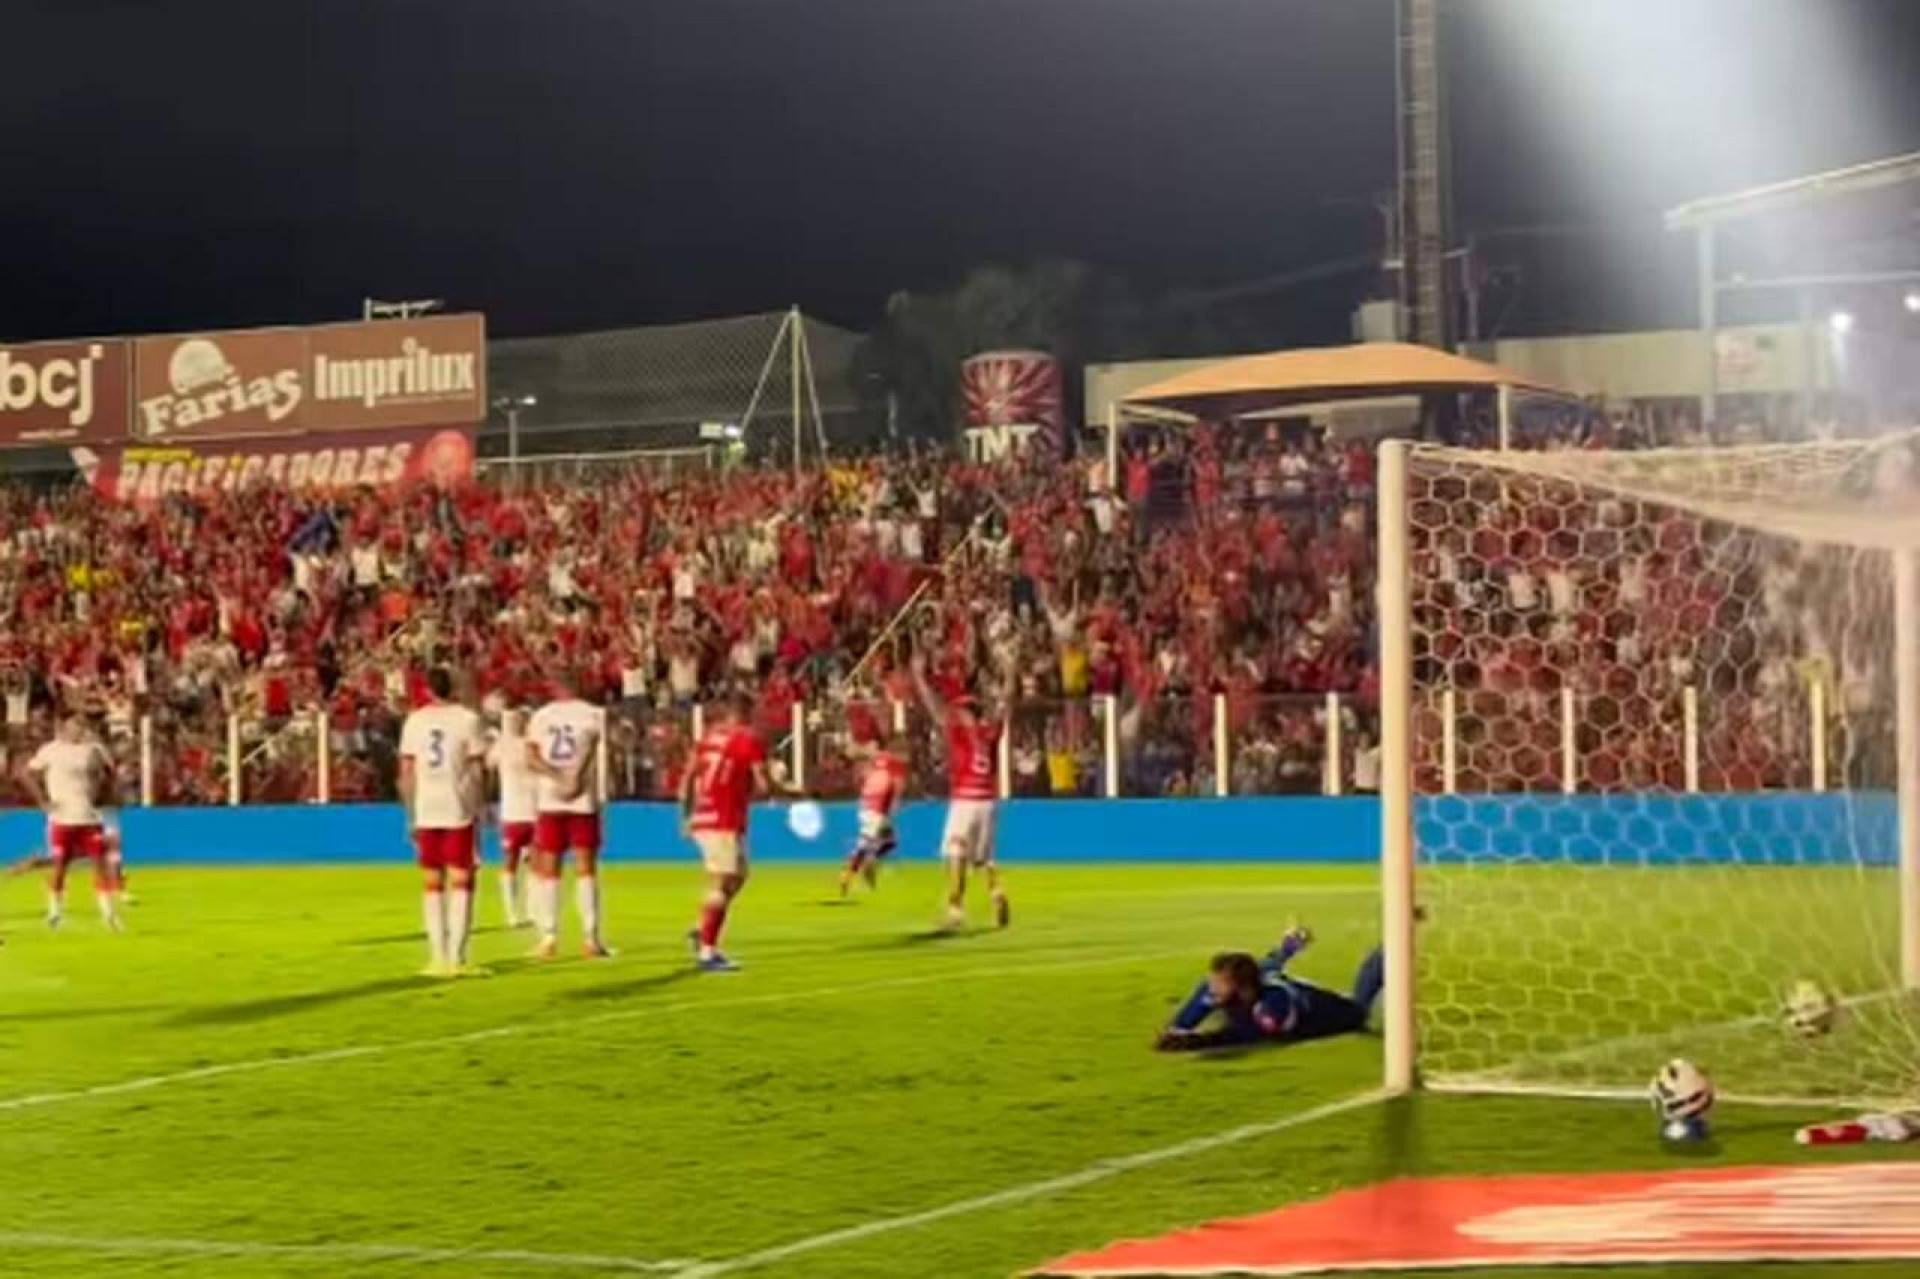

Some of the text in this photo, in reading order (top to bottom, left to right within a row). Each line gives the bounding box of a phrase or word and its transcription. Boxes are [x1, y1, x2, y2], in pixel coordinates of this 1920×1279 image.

[315, 337, 475, 408] Imprilux
[139, 369, 302, 436] Farias
[964, 424, 1040, 463] TNT
[429, 729, 443, 767] 3
[550, 725, 576, 760] 25
